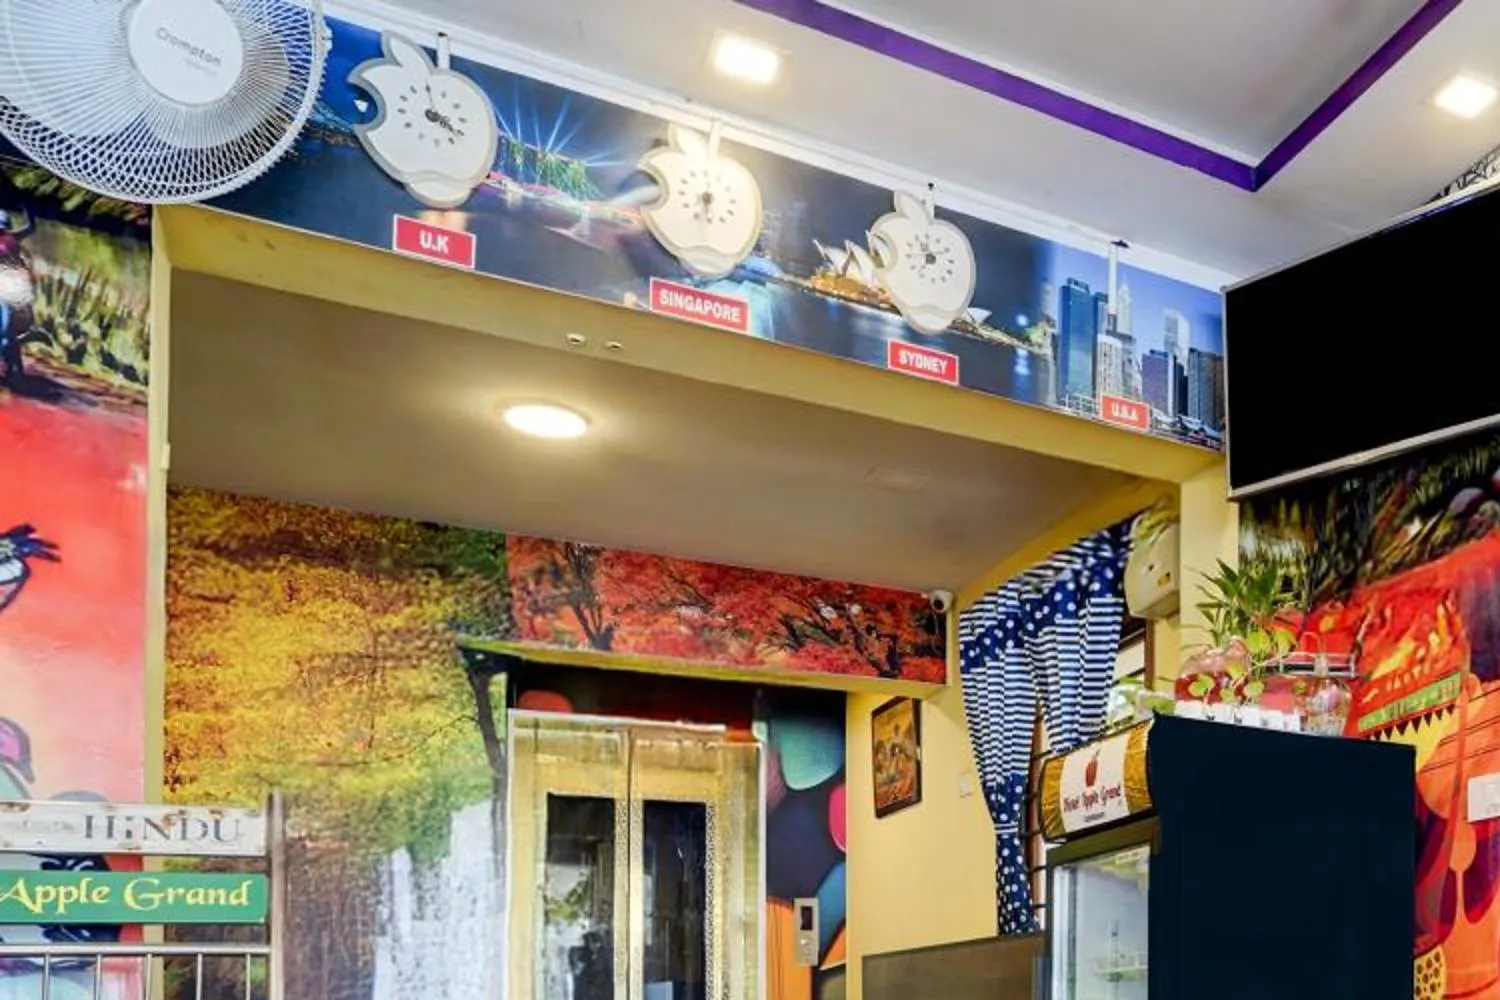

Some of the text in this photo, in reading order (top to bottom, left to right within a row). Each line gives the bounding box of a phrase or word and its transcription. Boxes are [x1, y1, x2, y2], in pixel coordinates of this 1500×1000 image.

[157, 26, 222, 65] Crompton
[420, 229, 450, 255] U.K
[659, 288, 741, 323] SINGAPORE
[899, 349, 948, 375] SYDNEY
[0, 877, 253, 915] Apple Grand
